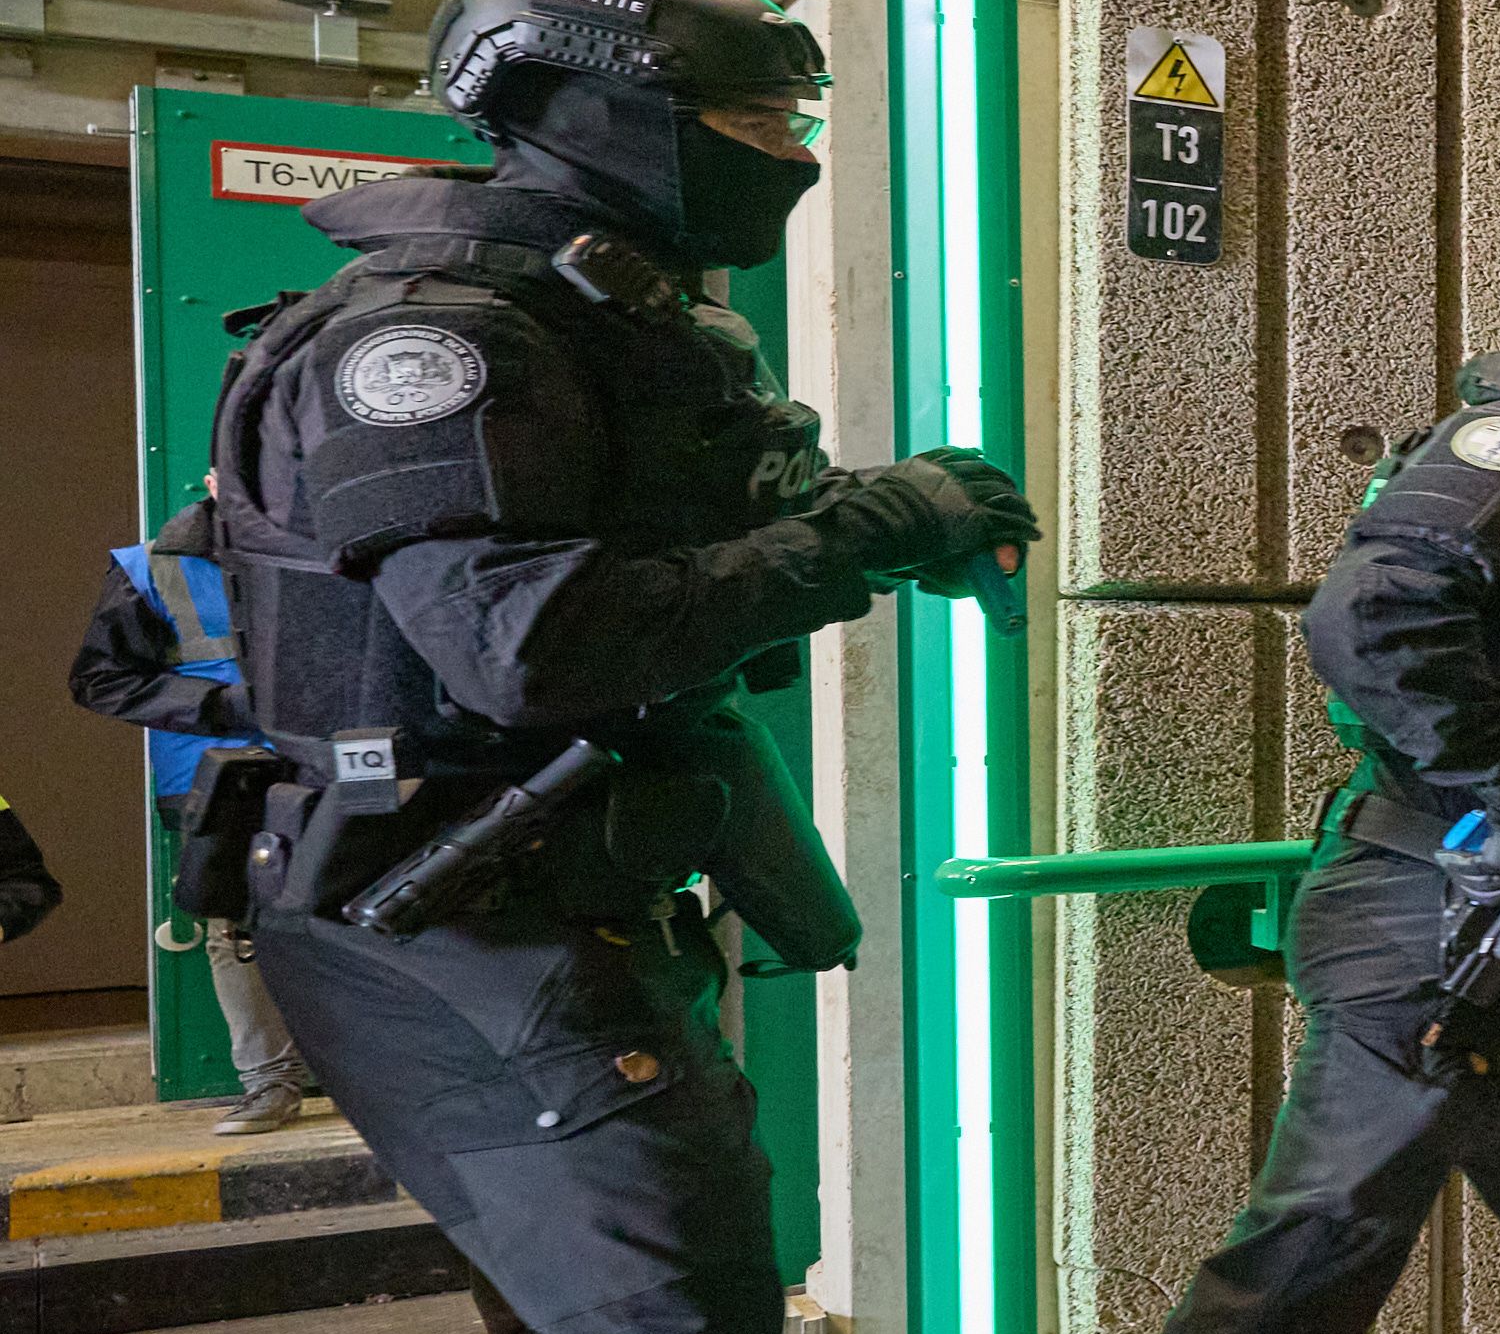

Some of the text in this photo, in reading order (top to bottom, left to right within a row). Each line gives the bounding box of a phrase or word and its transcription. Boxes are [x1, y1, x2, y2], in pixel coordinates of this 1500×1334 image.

[1155, 122, 1200, 165] T3
[1141, 198, 1207, 244] 102
[342, 750, 387, 769] TQ
